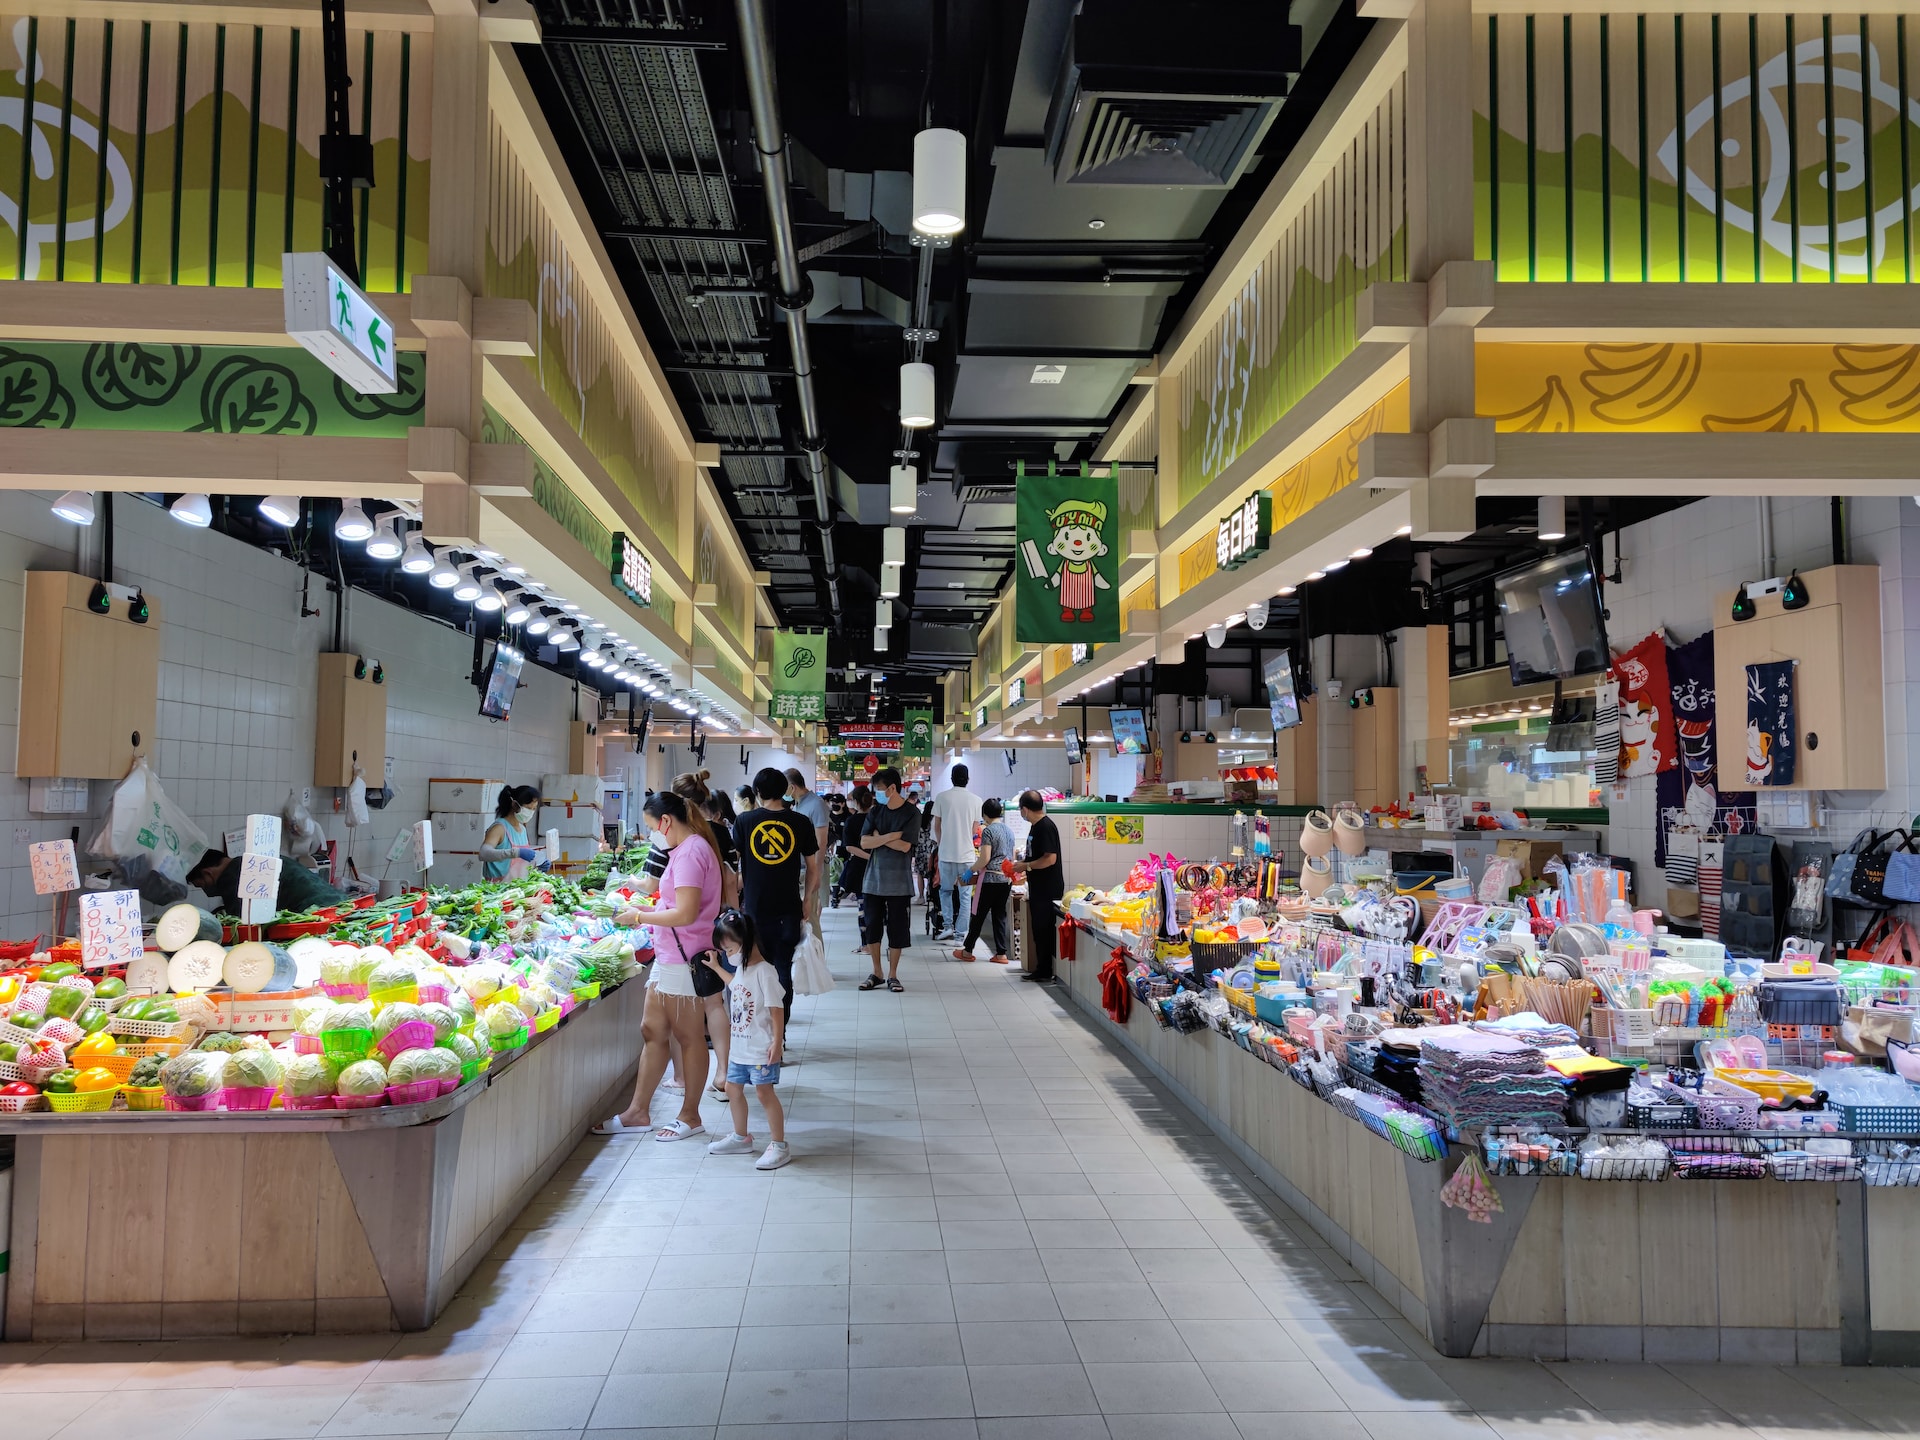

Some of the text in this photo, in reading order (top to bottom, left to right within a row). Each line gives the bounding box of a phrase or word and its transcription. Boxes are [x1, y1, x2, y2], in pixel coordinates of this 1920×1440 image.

[776, 694, 820, 717] 蔬菜
[38, 841, 65, 852] 全部
[87, 891, 134, 908] 全部
